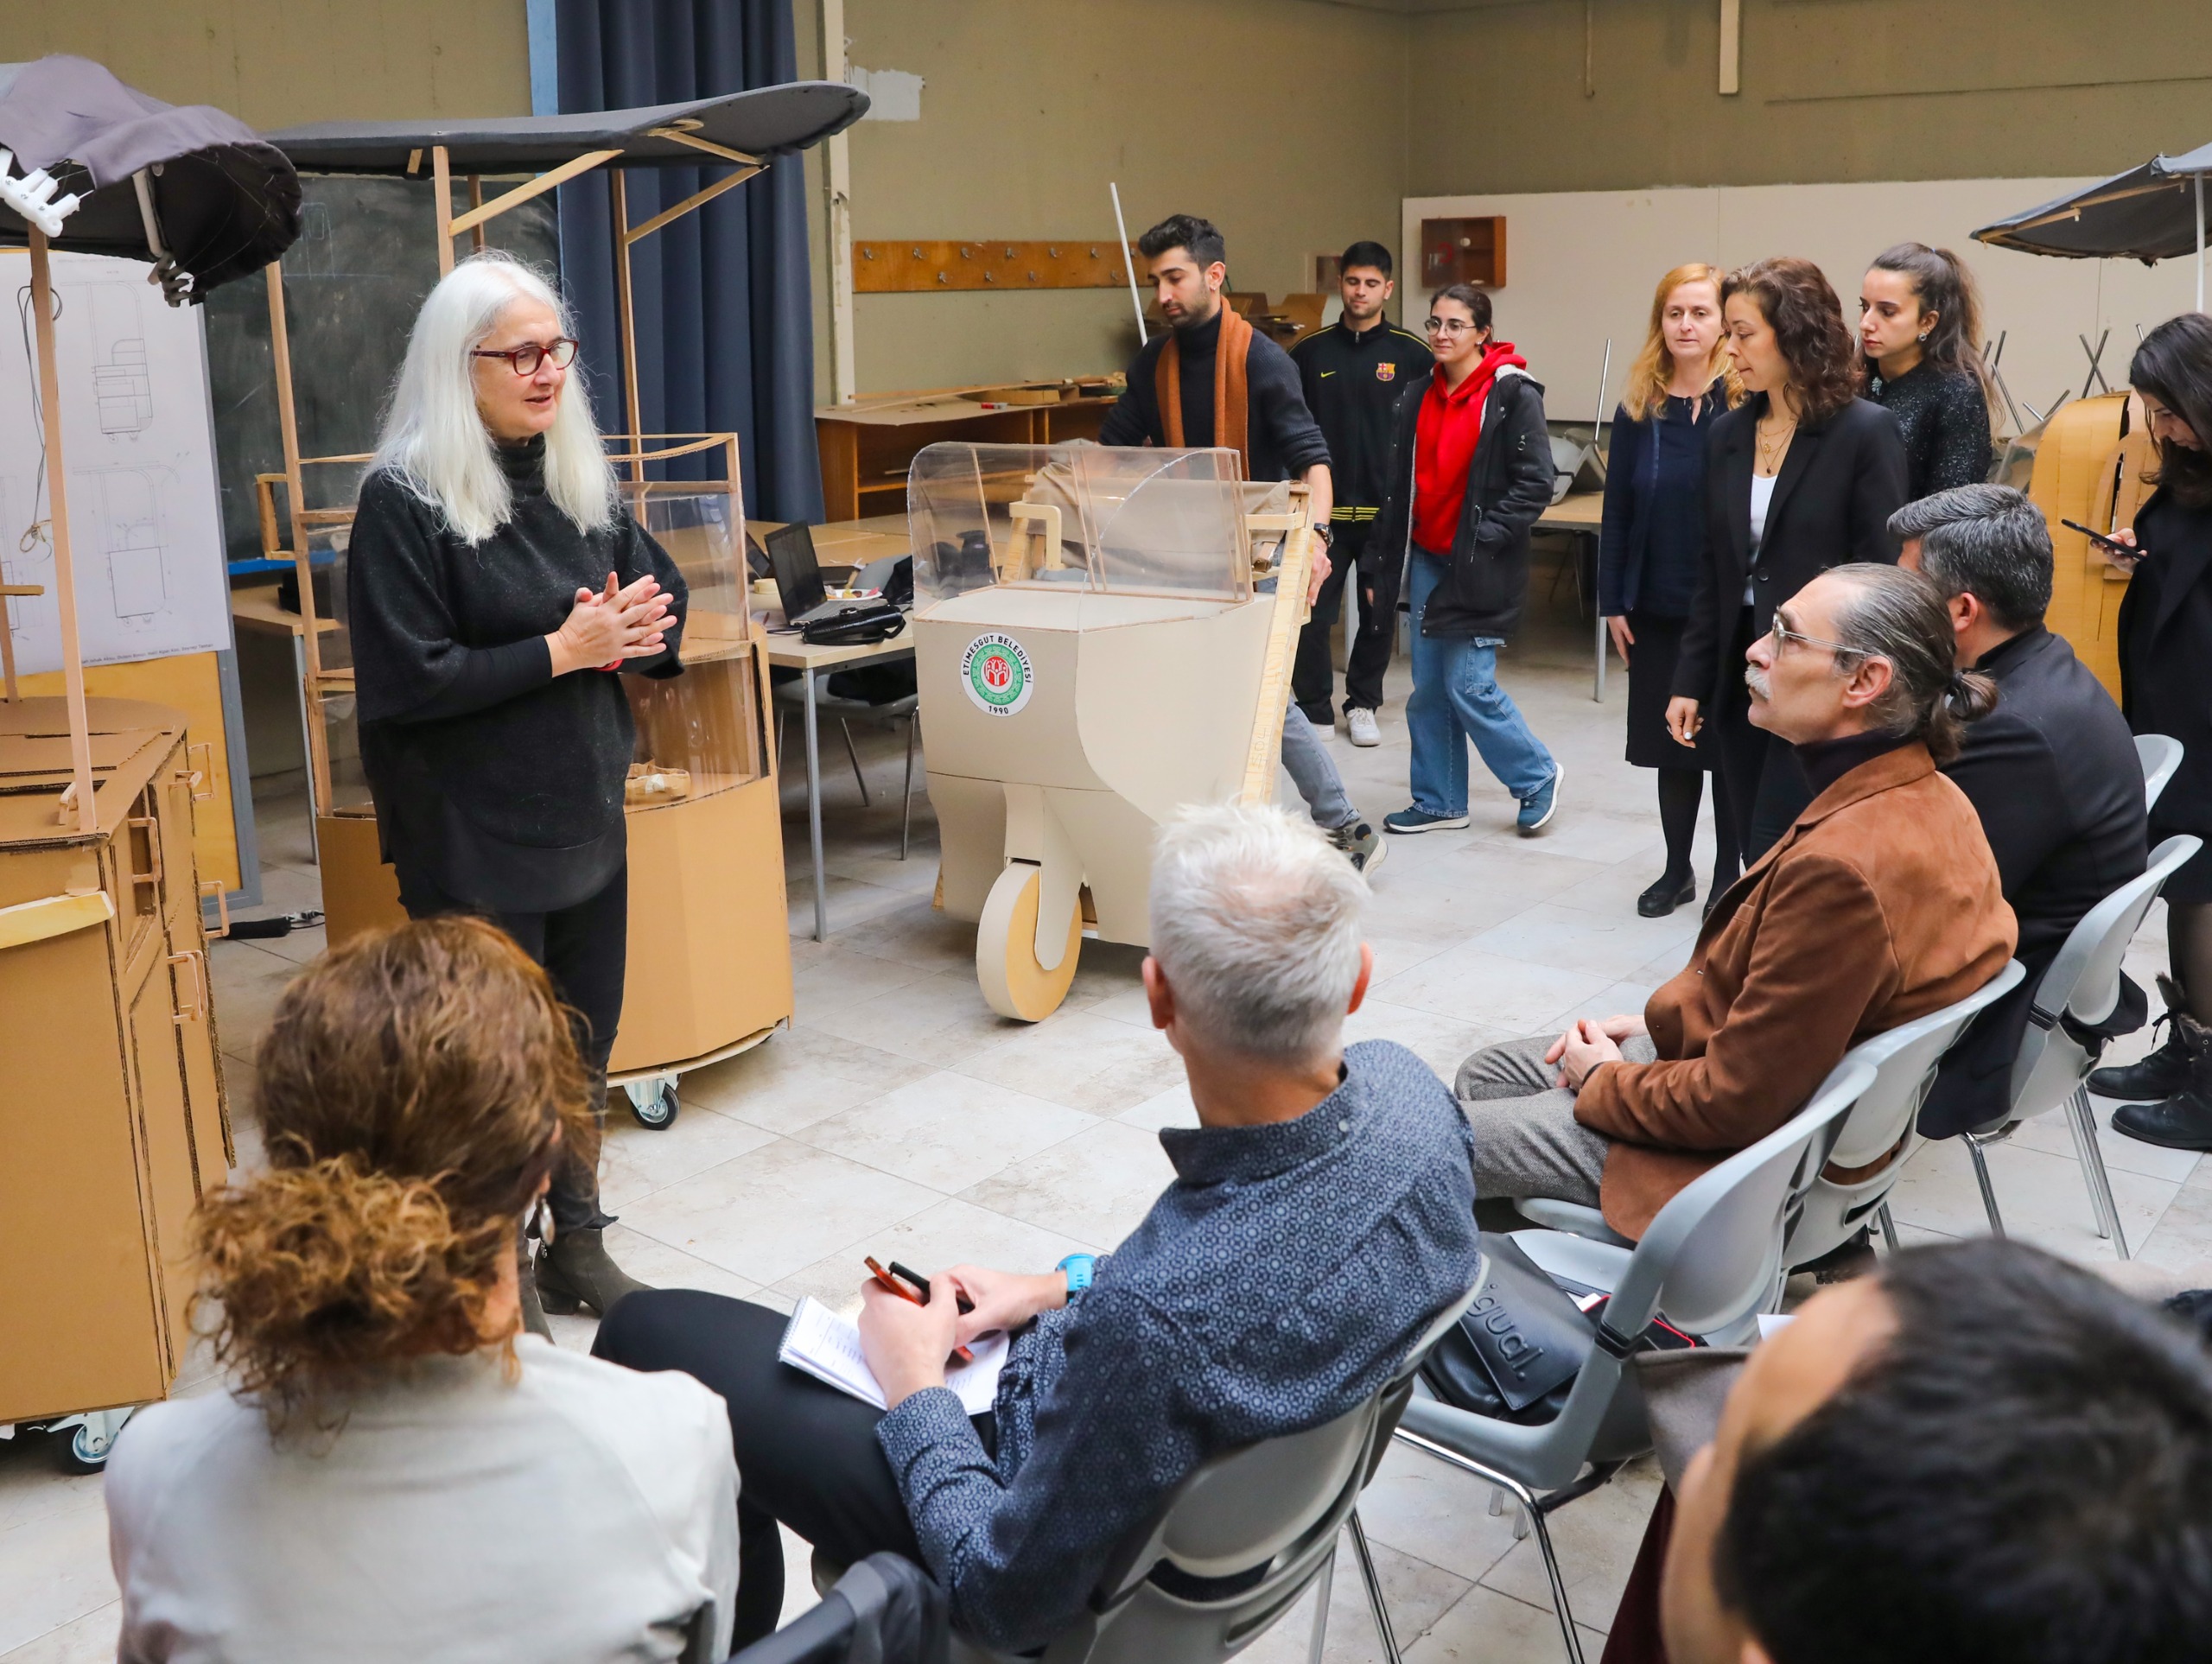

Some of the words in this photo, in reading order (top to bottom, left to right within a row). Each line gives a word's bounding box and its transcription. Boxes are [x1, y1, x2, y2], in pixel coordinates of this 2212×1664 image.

[963, 635, 994, 676] ETİMESGUT
[997, 635, 1033, 683] BELEDİYESİ
[988, 705, 1008, 715] 1990
